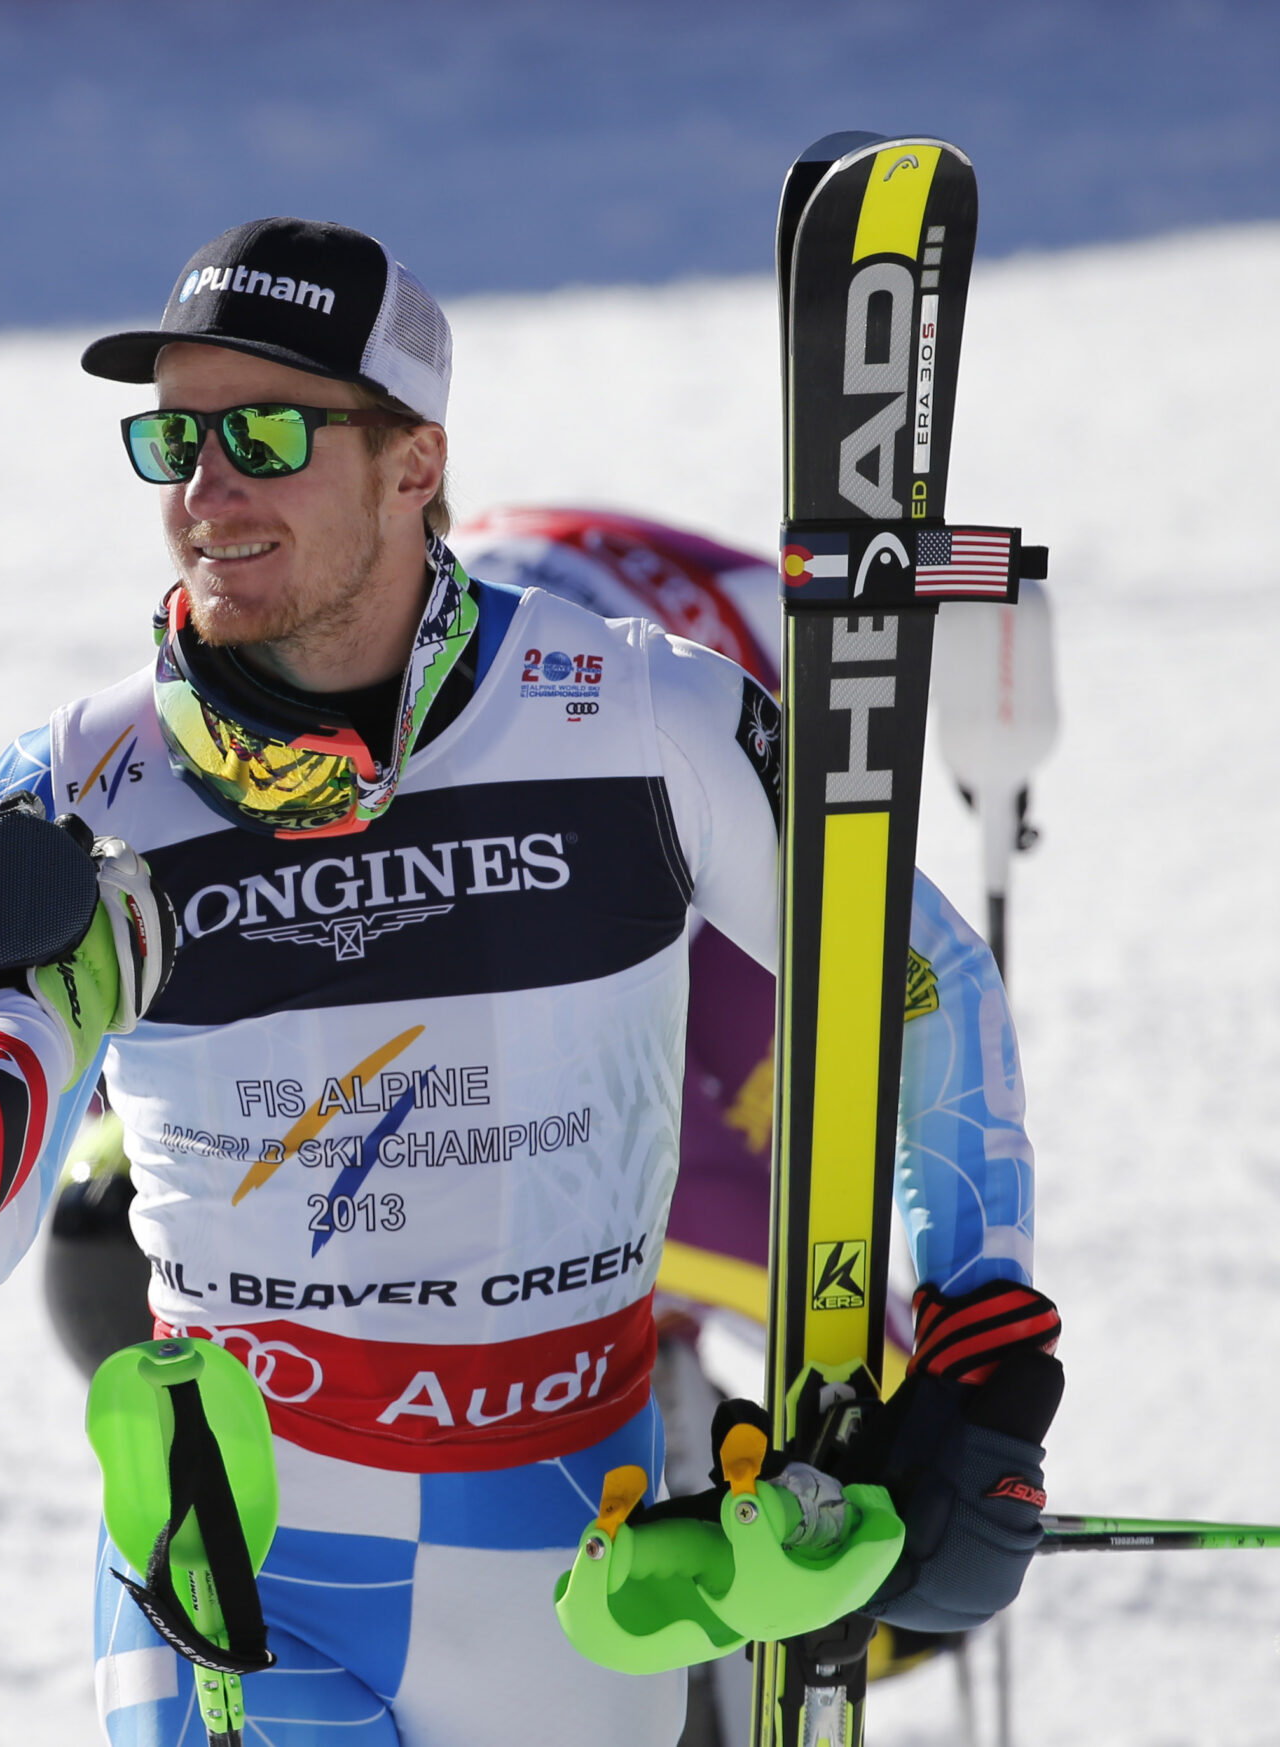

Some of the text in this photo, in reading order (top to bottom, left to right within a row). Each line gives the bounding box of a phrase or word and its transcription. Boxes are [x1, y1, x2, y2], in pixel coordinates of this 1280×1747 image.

[194, 264, 336, 316] Putnam
[920, 345, 933, 382] 3.0
[917, 393, 931, 446] ERA
[911, 480, 927, 519] ED
[235, 1065, 491, 1119] FIS ALPINE
[297, 1135, 365, 1169] SKI
[377, 1108, 591, 1169] CHAMPION
[306, 1193, 407, 1233] 2013
[229, 1271, 458, 1311] BEAVER
[480, 1232, 648, 1307] CREEK
[813, 1295, 864, 1310] KERS
[375, 1342, 615, 1427] Audi
